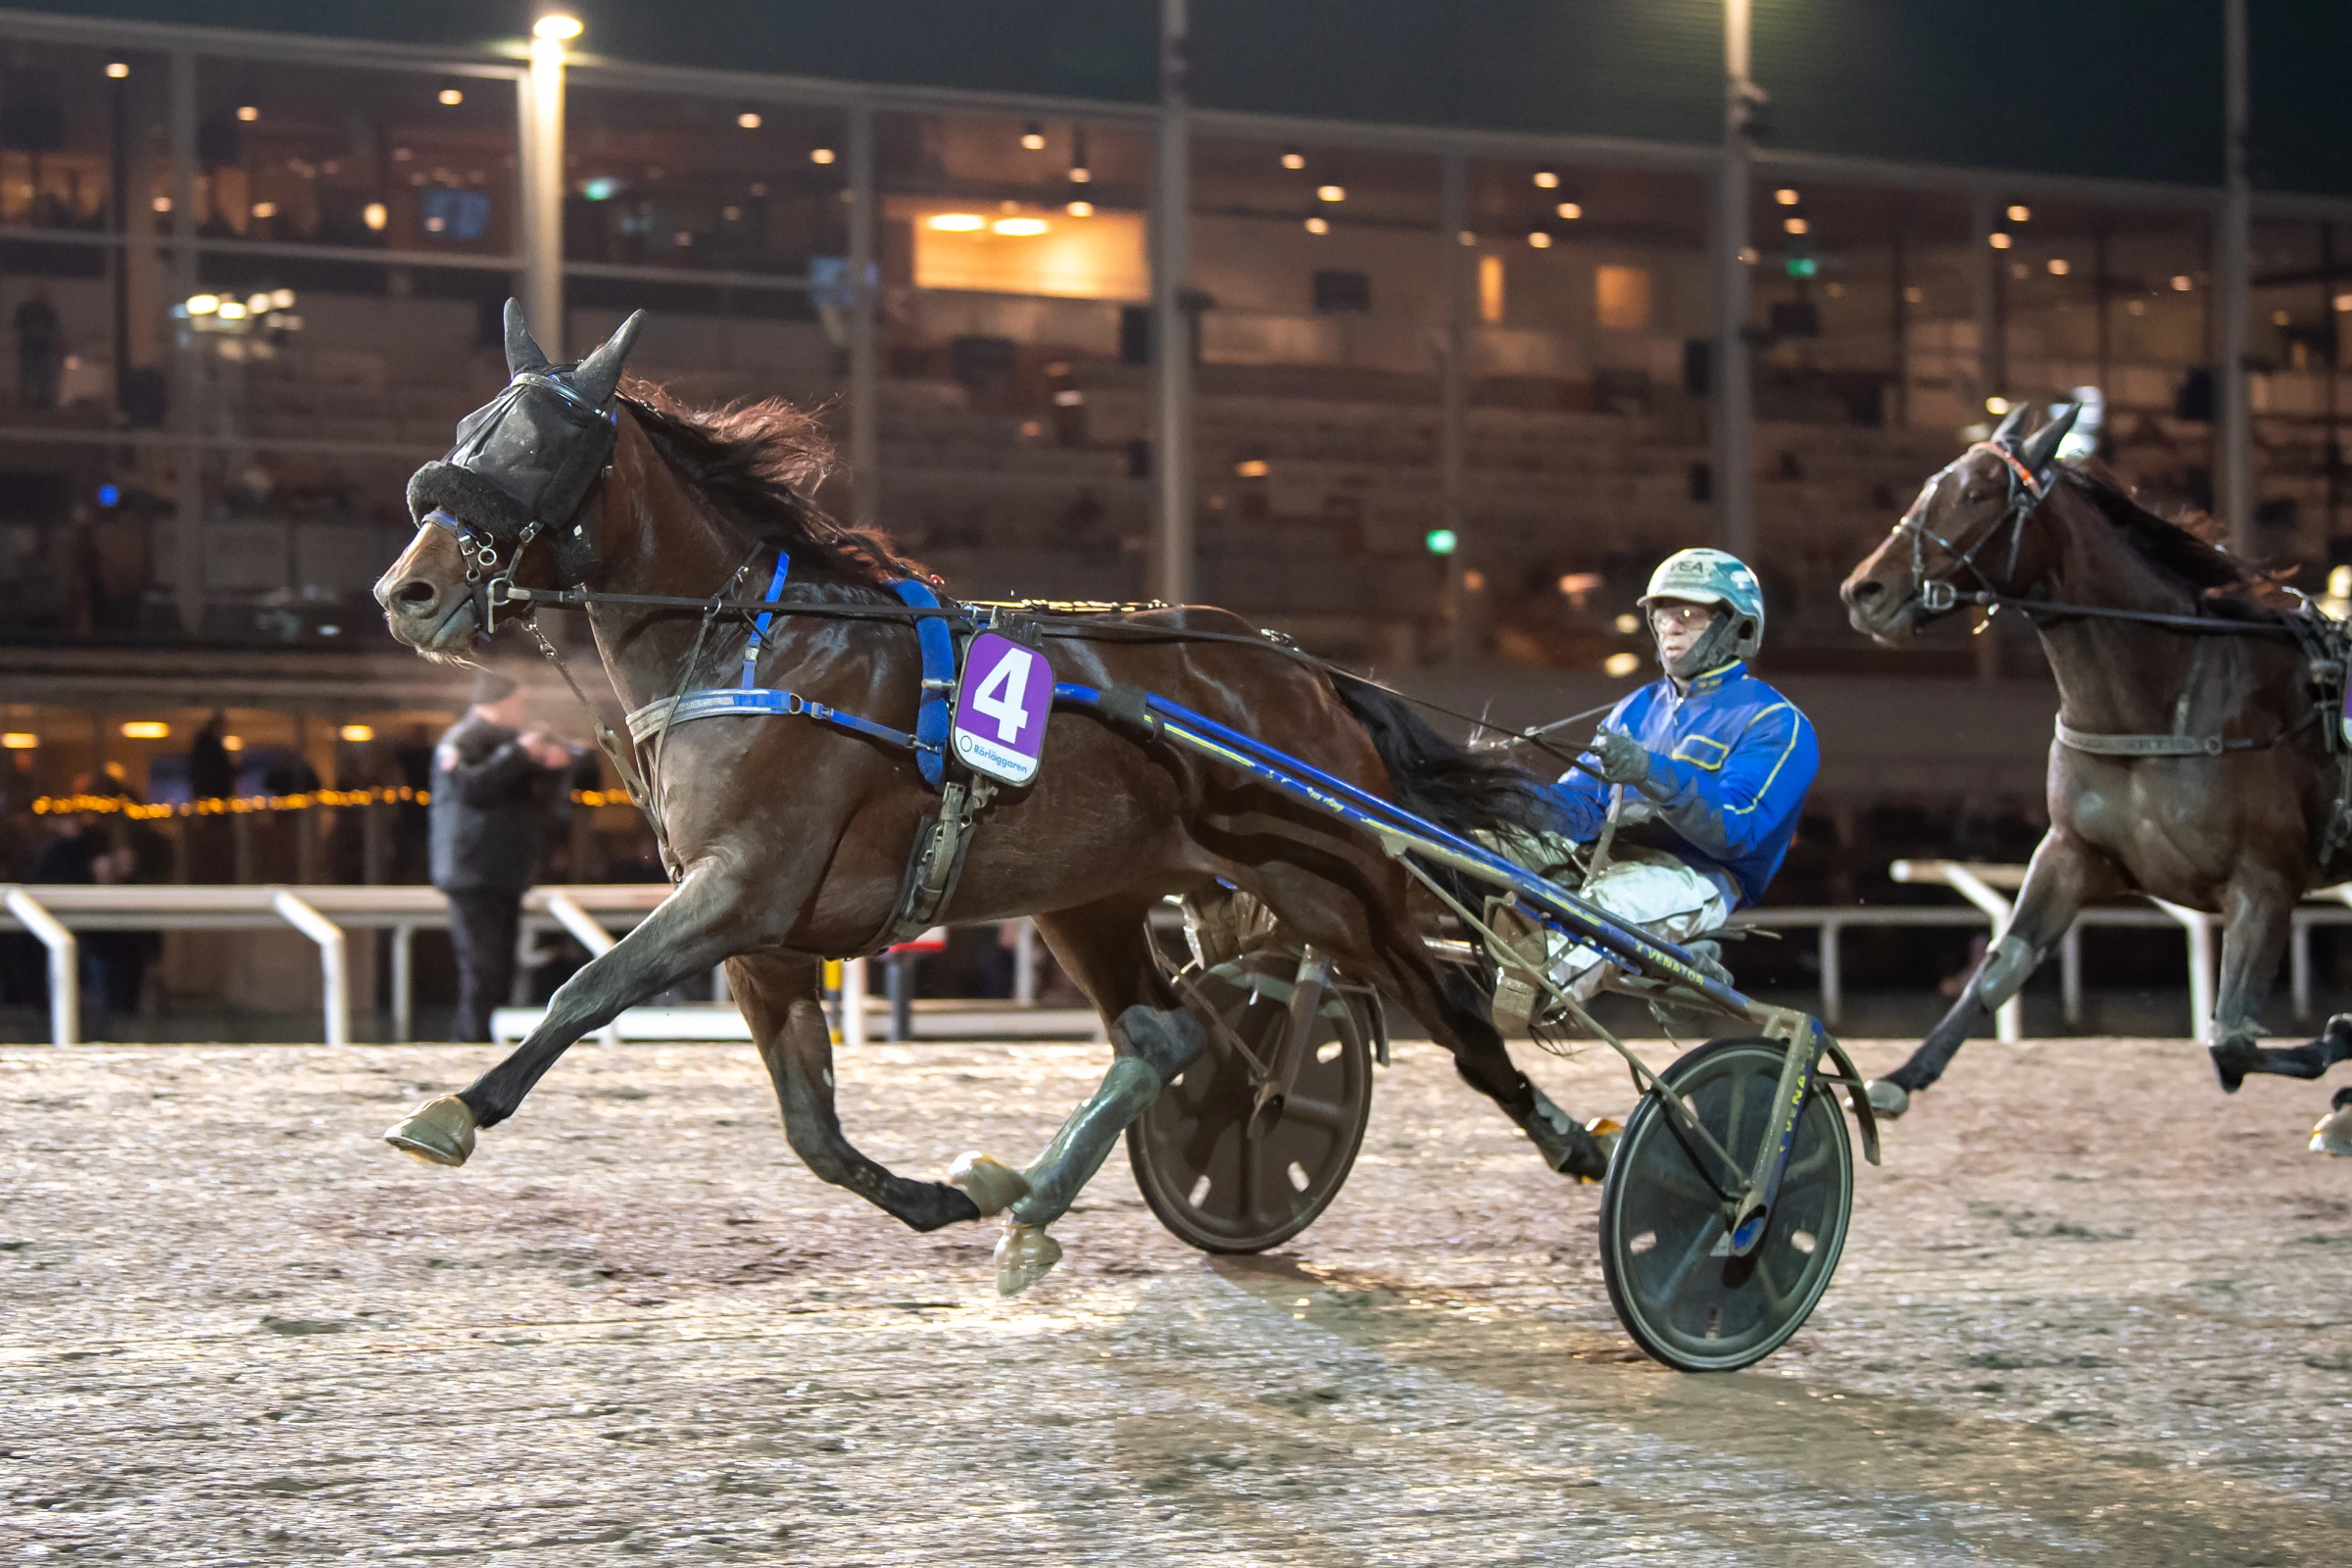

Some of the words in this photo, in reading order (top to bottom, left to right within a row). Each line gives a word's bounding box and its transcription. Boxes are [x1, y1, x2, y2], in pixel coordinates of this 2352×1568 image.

[972, 647, 1033, 745] 4
[973, 744, 1027, 774] Rörläggaren
[1646, 945, 1704, 986] VENATOR
